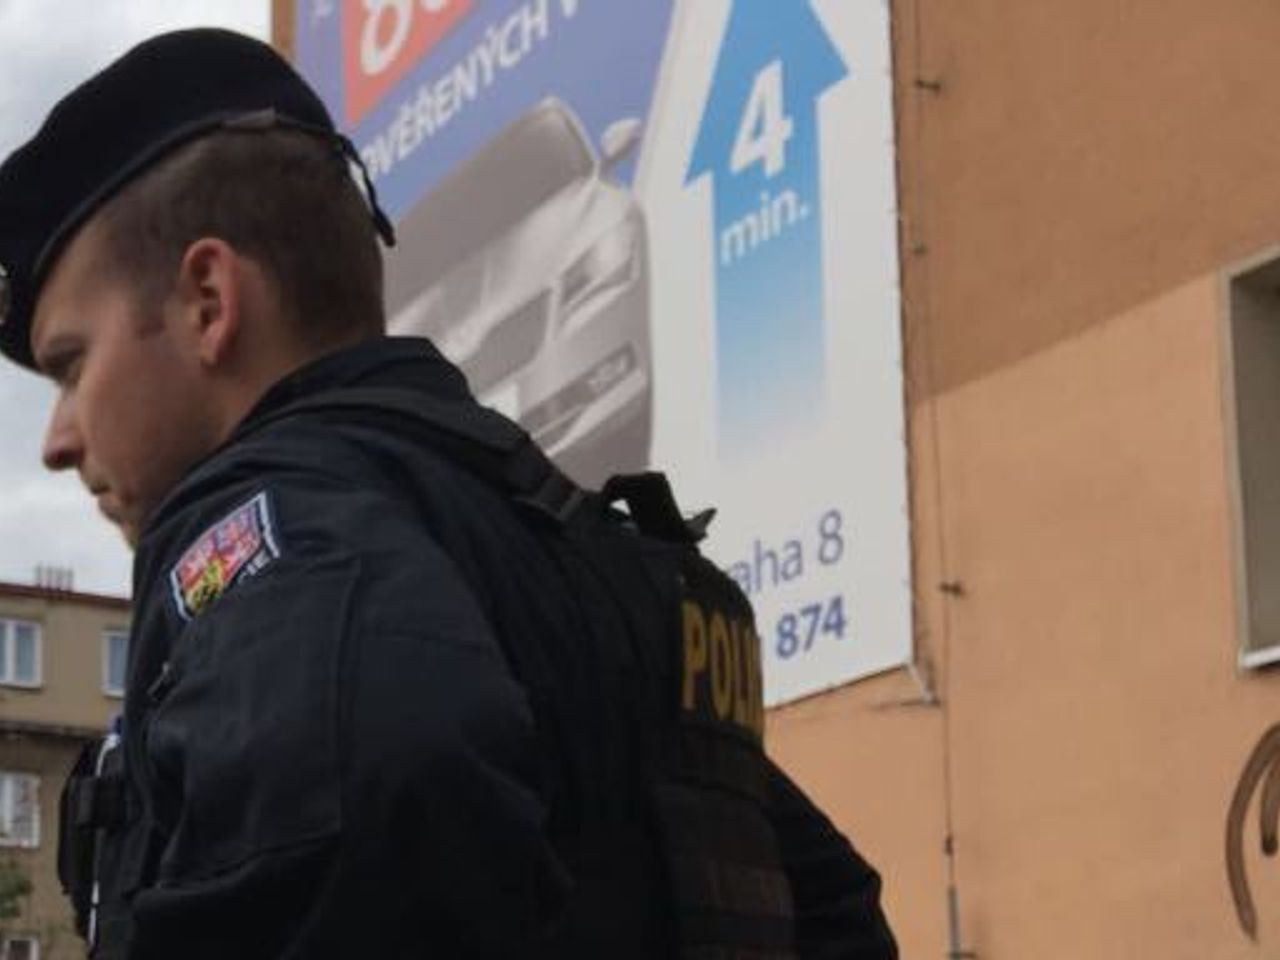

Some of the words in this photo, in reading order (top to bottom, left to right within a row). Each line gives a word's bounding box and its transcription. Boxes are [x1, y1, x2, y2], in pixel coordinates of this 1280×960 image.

[729, 58, 794, 180] 4
[721, 189, 810, 268] min.
[819, 509, 845, 566] 8
[776, 596, 847, 660] 874
